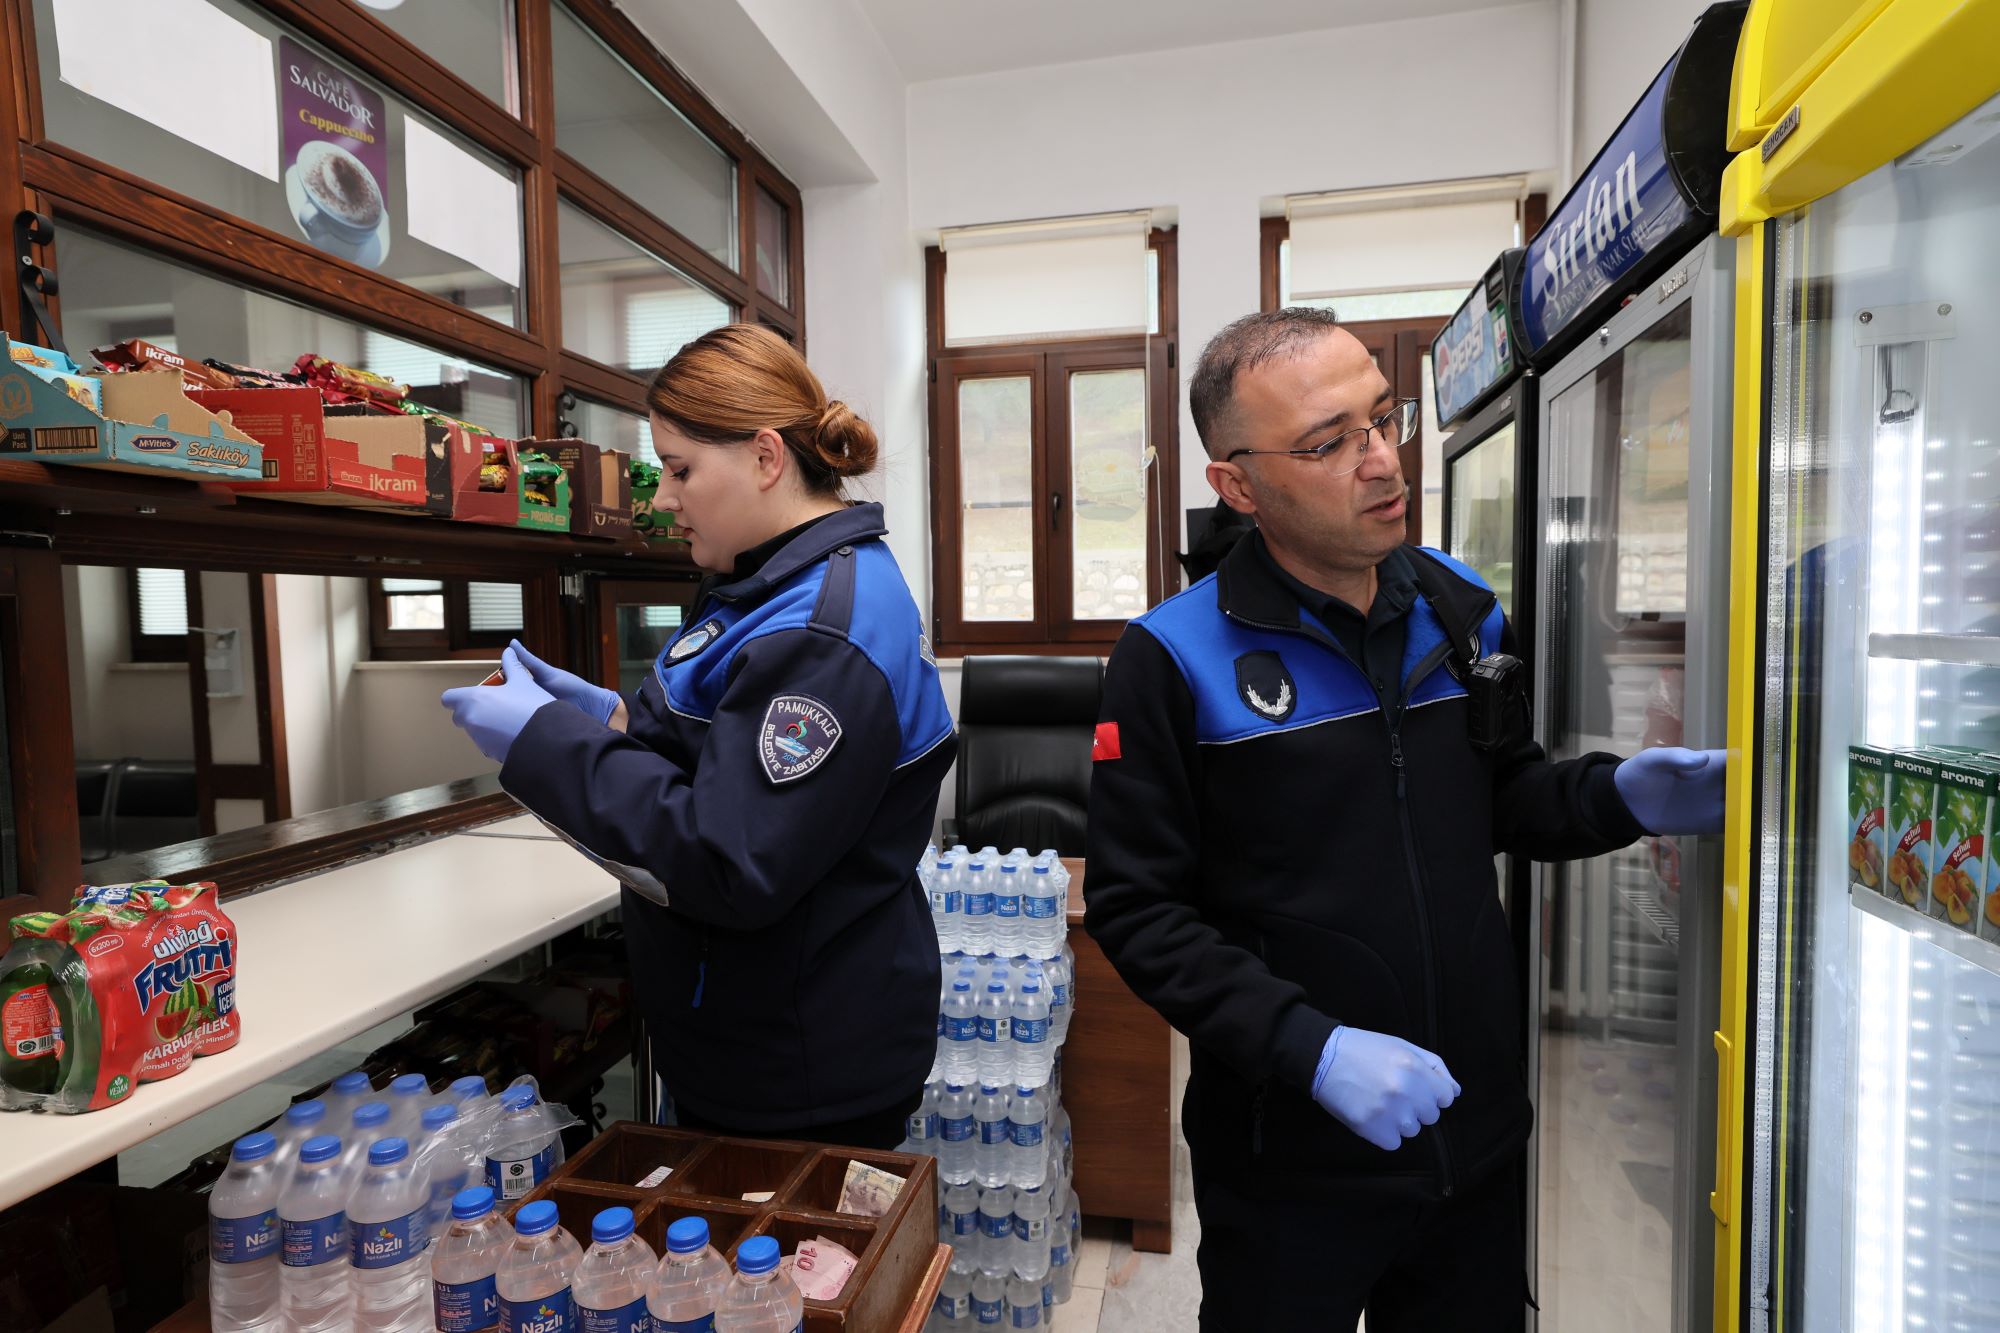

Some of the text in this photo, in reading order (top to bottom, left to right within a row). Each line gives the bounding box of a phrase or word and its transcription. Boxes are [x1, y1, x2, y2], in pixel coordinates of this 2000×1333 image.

[290, 64, 375, 129] SALVADOR
[299, 108, 375, 144] Cappuccino
[145, 347, 185, 366] ikram
[1450, 318, 1484, 380] PEPSI
[138, 439, 172, 448] McVitie's
[187, 440, 249, 468] Saklıköy
[369, 473, 417, 492] ikram
[777, 701, 837, 738] PAMUKKALE
[764, 723, 826, 775] BELEDİYE ZABITASI
[1848, 751, 1882, 766] aroma
[1893, 759, 1933, 776] aroma
[1941, 770, 1985, 788] aroma
[153, 920, 214, 959] uludağ
[142, 1031, 193, 1064] KARPUZ
[194, 1016, 230, 1039] ÇİLEK
[363, 1237, 403, 1255] Nazlı
[797, 1247, 818, 1271] 10
[521, 1314, 563, 1333] Nazlı
